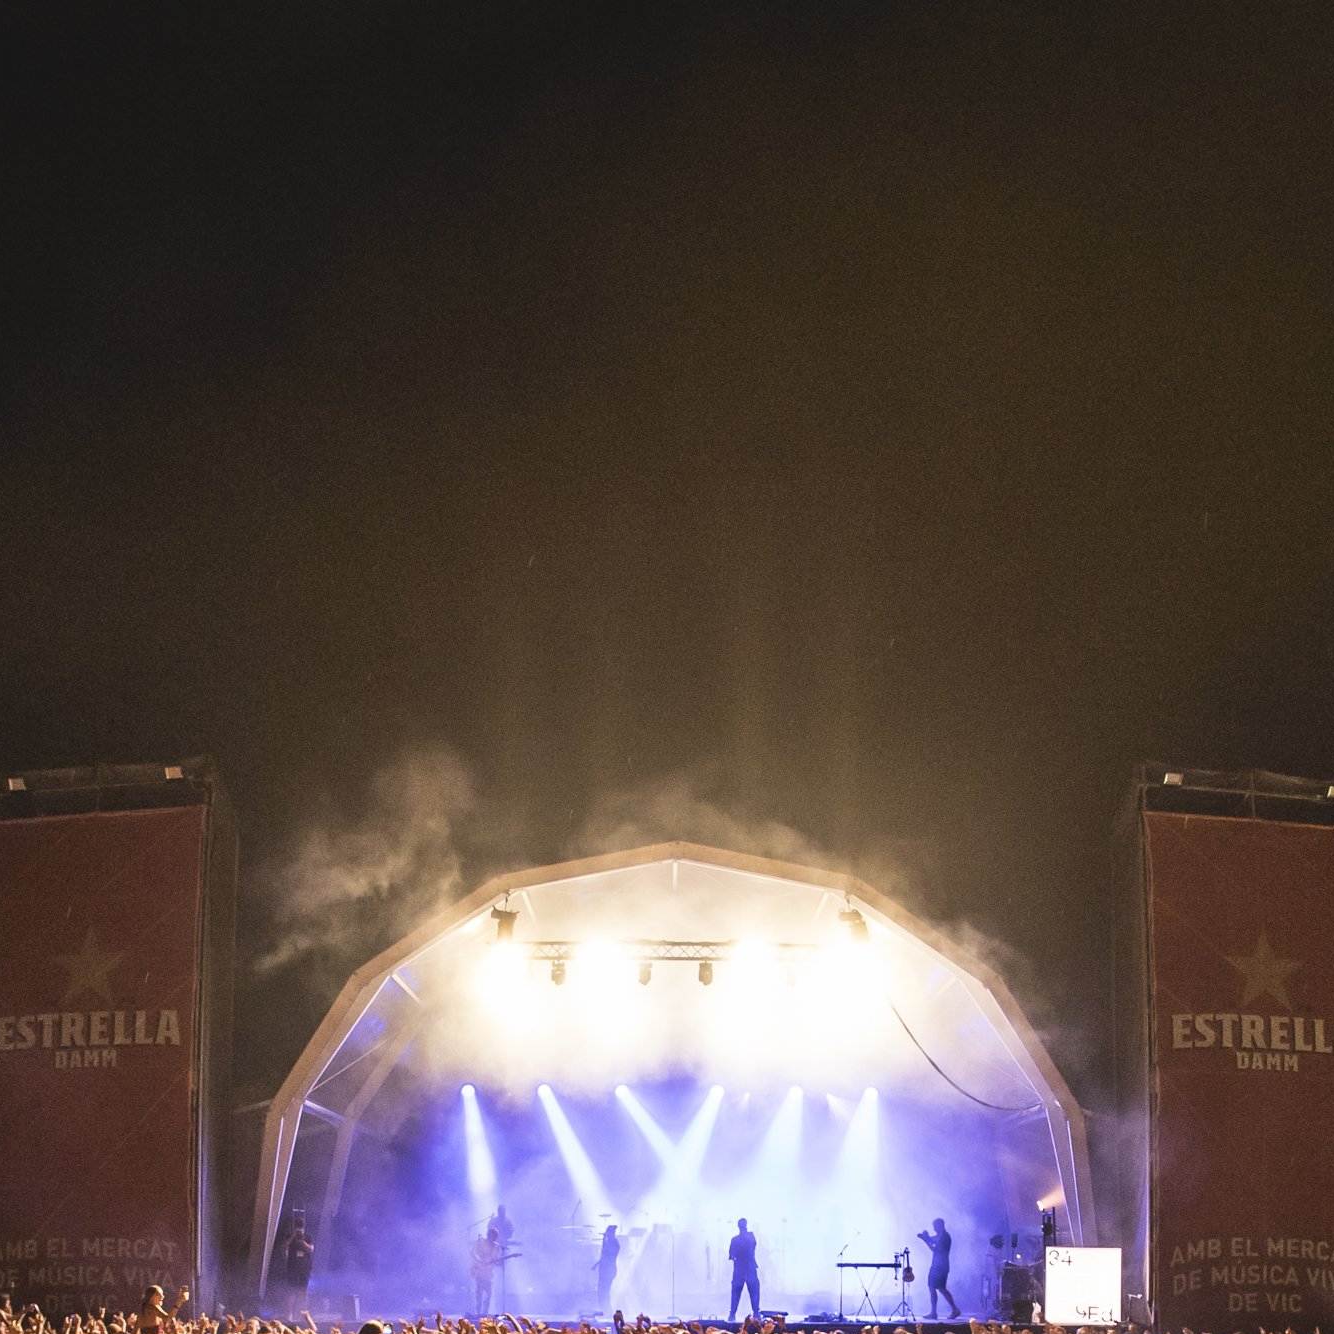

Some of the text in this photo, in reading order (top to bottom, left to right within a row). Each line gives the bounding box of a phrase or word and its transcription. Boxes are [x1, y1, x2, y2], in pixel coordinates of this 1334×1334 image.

[55, 1050, 117, 1069] DAMM
[1236, 1051, 1299, 1072] DAMM
[47, 1238, 76, 1258] EL
[82, 1238, 178, 1263] MERCAT
[1170, 1238, 1222, 1267] AMB
[1231, 1237, 1259, 1257] EL
[28, 1261, 117, 1286] MÚSICA
[123, 1266, 176, 1289] VIVA
[1173, 1269, 1203, 1296] DE
[1211, 1261, 1300, 1286] MÚSICA
[1228, 1292, 1302, 1313] DE VIC
